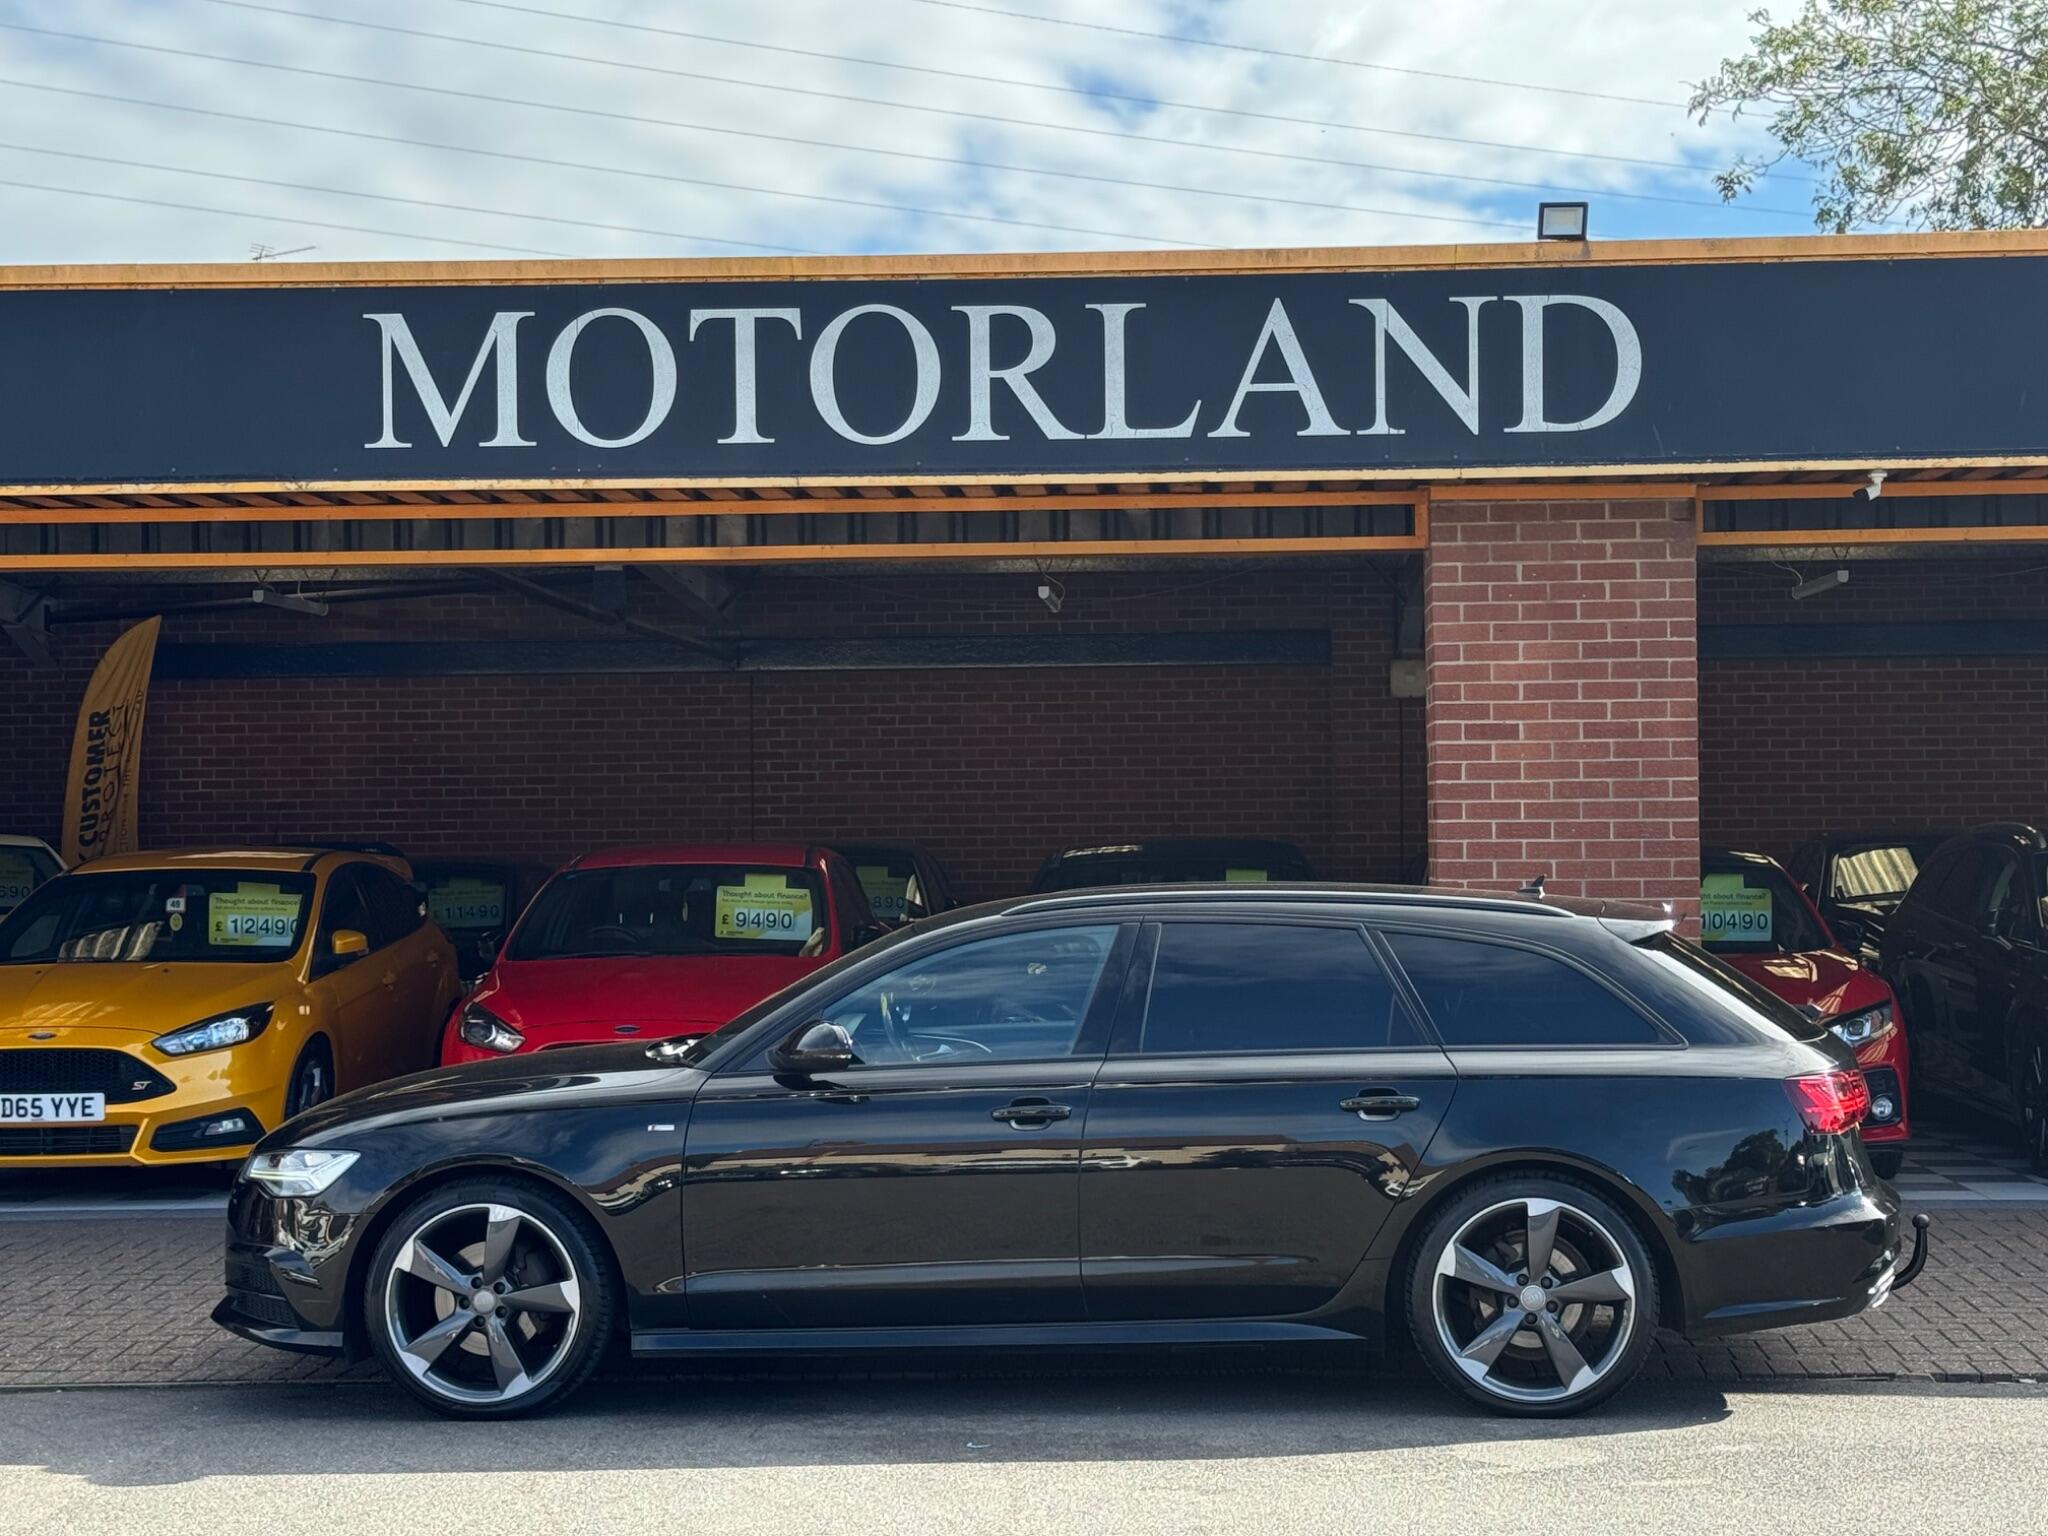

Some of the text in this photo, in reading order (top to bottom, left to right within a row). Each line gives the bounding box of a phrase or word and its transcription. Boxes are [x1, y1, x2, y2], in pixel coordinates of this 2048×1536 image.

[363, 294, 1642, 449] MOTORLAND
[79, 711, 110, 846] CUSTOMER
[216, 897, 245, 906] Thought
[722, 889, 807, 900] Thought about finance?
[445, 905, 499, 919] 11490
[721, 912, 792, 929] £ 9490
[215, 918, 297, 935] £ 12490
[1701, 913, 1768, 930] 10490
[131, 1080, 152, 1090] ST
[1, 1097, 95, 1118] D65 YYE
